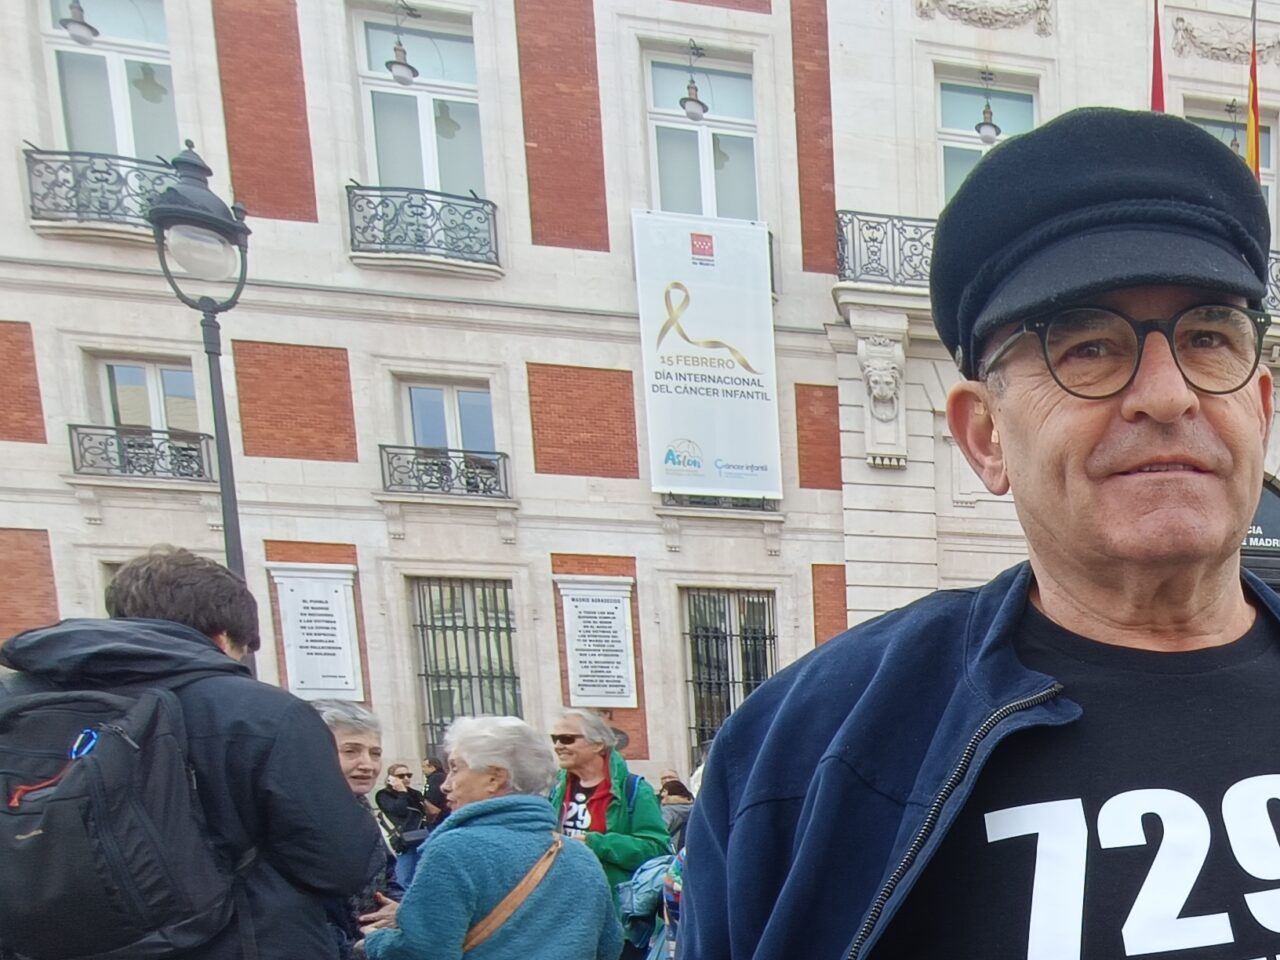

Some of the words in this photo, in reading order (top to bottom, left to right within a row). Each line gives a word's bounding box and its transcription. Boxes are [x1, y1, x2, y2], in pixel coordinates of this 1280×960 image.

[660, 356, 674, 366] 15
[676, 355, 735, 369] FEBRERO
[654, 368, 673, 381] DÍA
[675, 372, 765, 388] INTERNACIONAL
[651, 384, 672, 394] DEL
[674, 382, 720, 398] CÁNCER
[722, 388, 771, 401] INFANTIL
